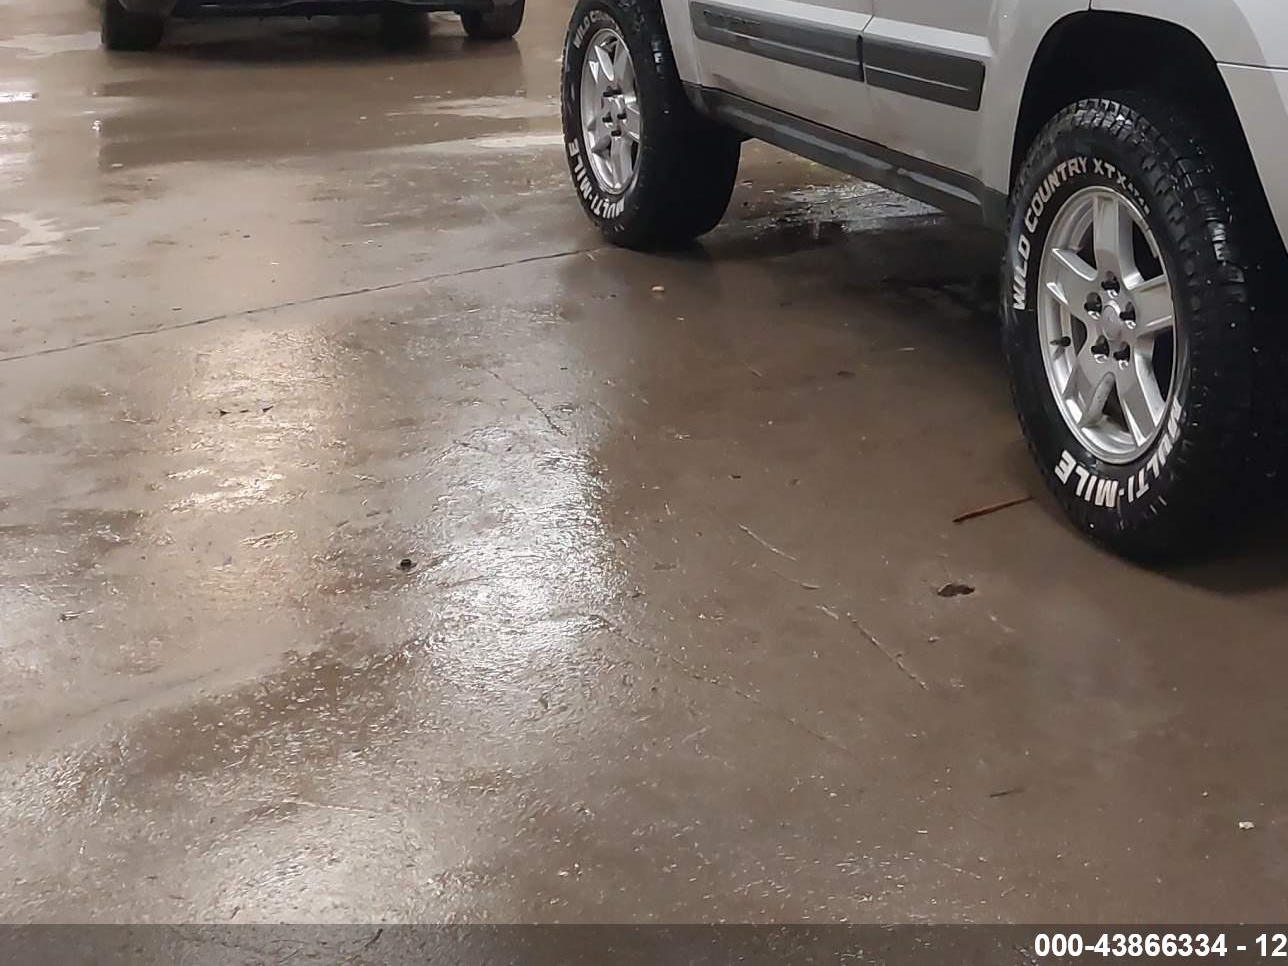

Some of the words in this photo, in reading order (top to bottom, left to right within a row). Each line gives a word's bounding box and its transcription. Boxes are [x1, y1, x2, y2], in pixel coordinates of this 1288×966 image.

[1012, 234, 1031, 311] WILD
[1024, 155, 1088, 234] COUNTRY
[1093, 157, 1128, 190] XTX
